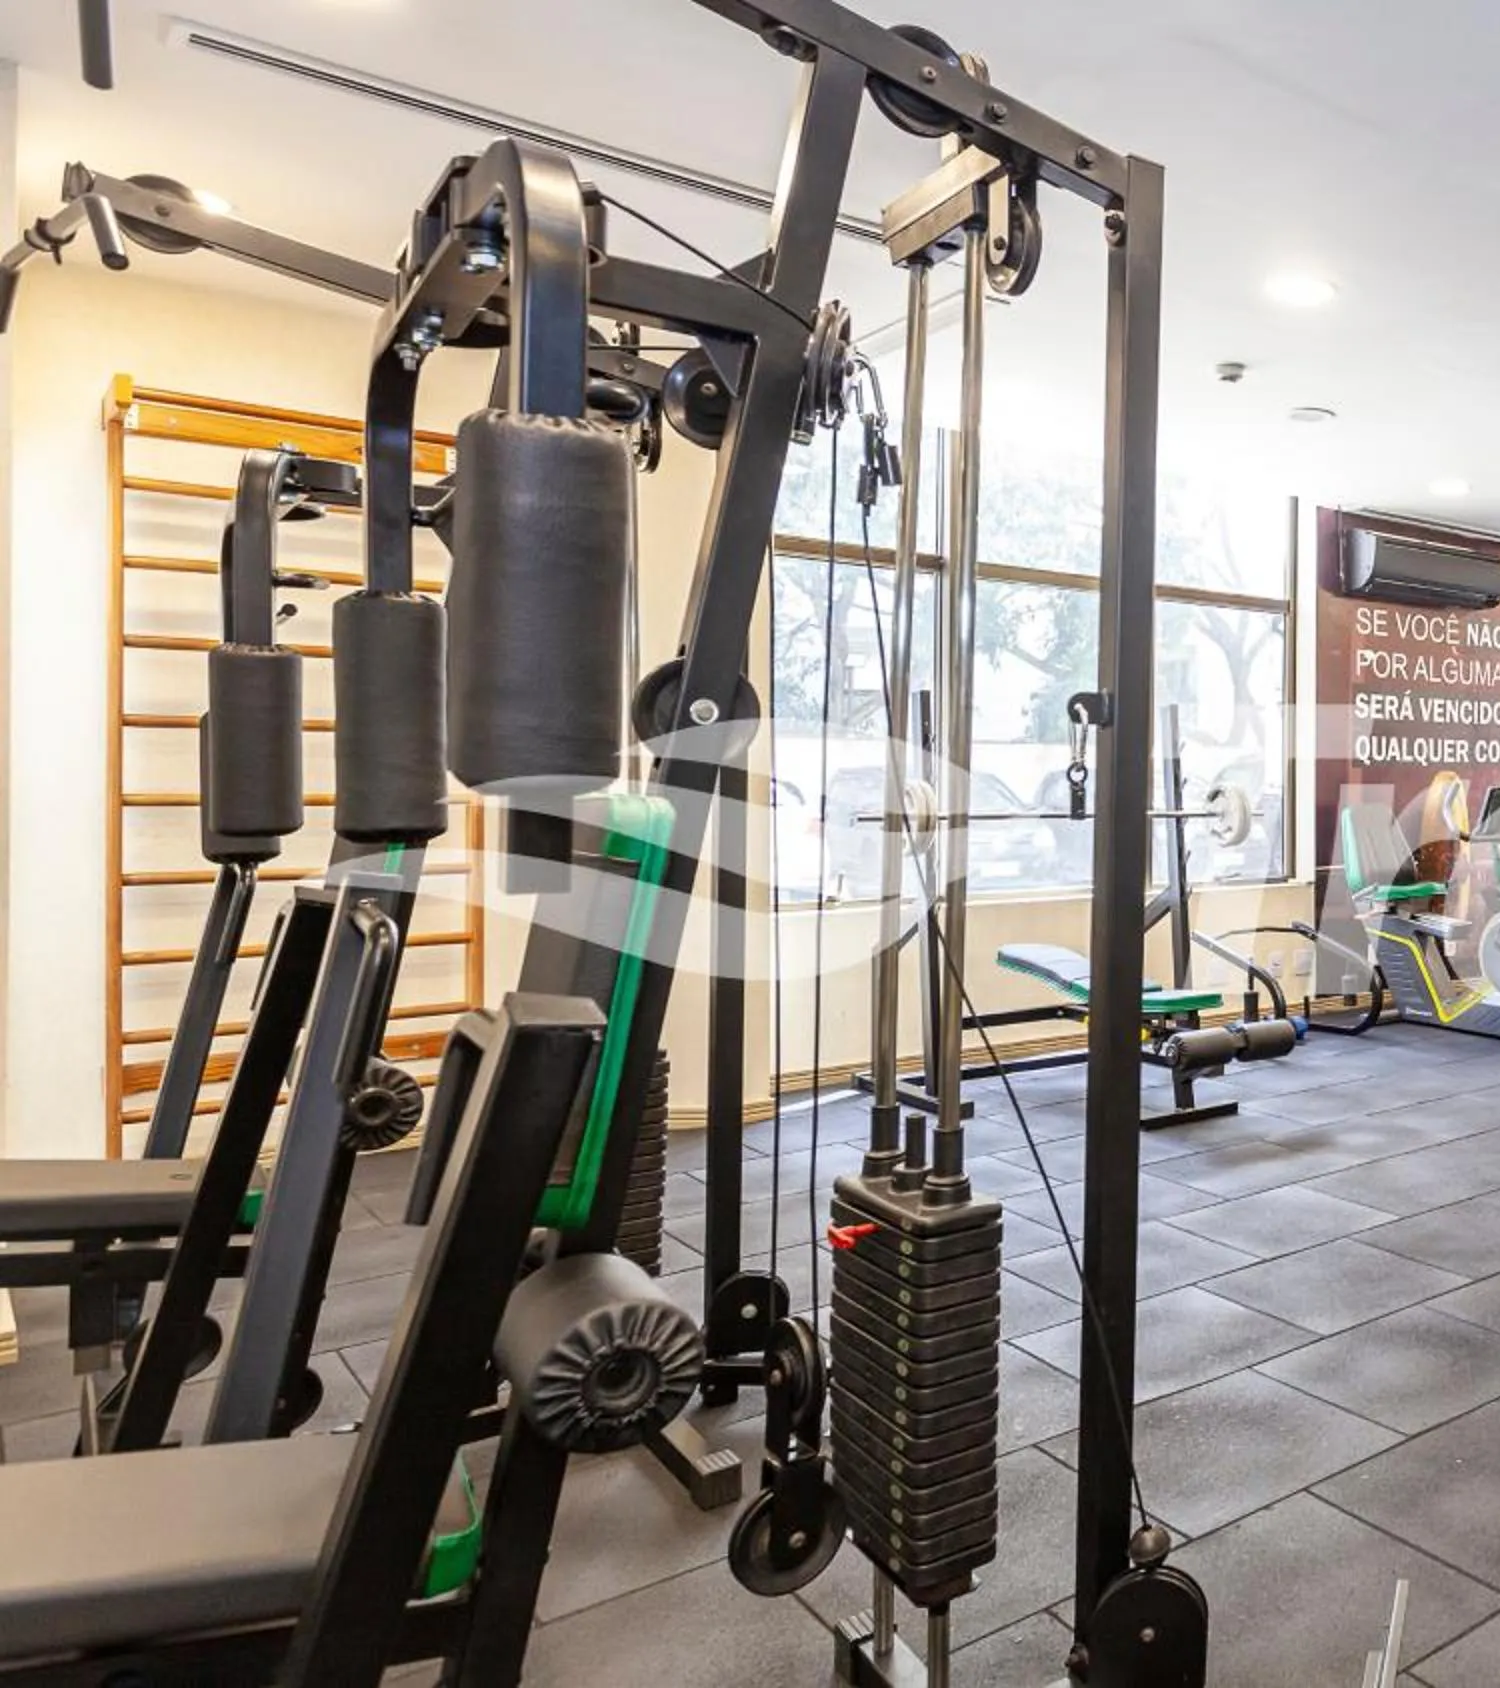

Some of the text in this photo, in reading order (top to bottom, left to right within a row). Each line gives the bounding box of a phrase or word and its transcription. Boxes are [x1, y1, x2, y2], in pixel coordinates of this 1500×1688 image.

[1356, 607, 1389, 637] SE
[1395, 612, 1460, 645] VOCÊ
[1356, 649, 1408, 681] POR
[1354, 689, 1415, 721] SERÁ
[1355, 735, 1470, 766] QUALQUER
